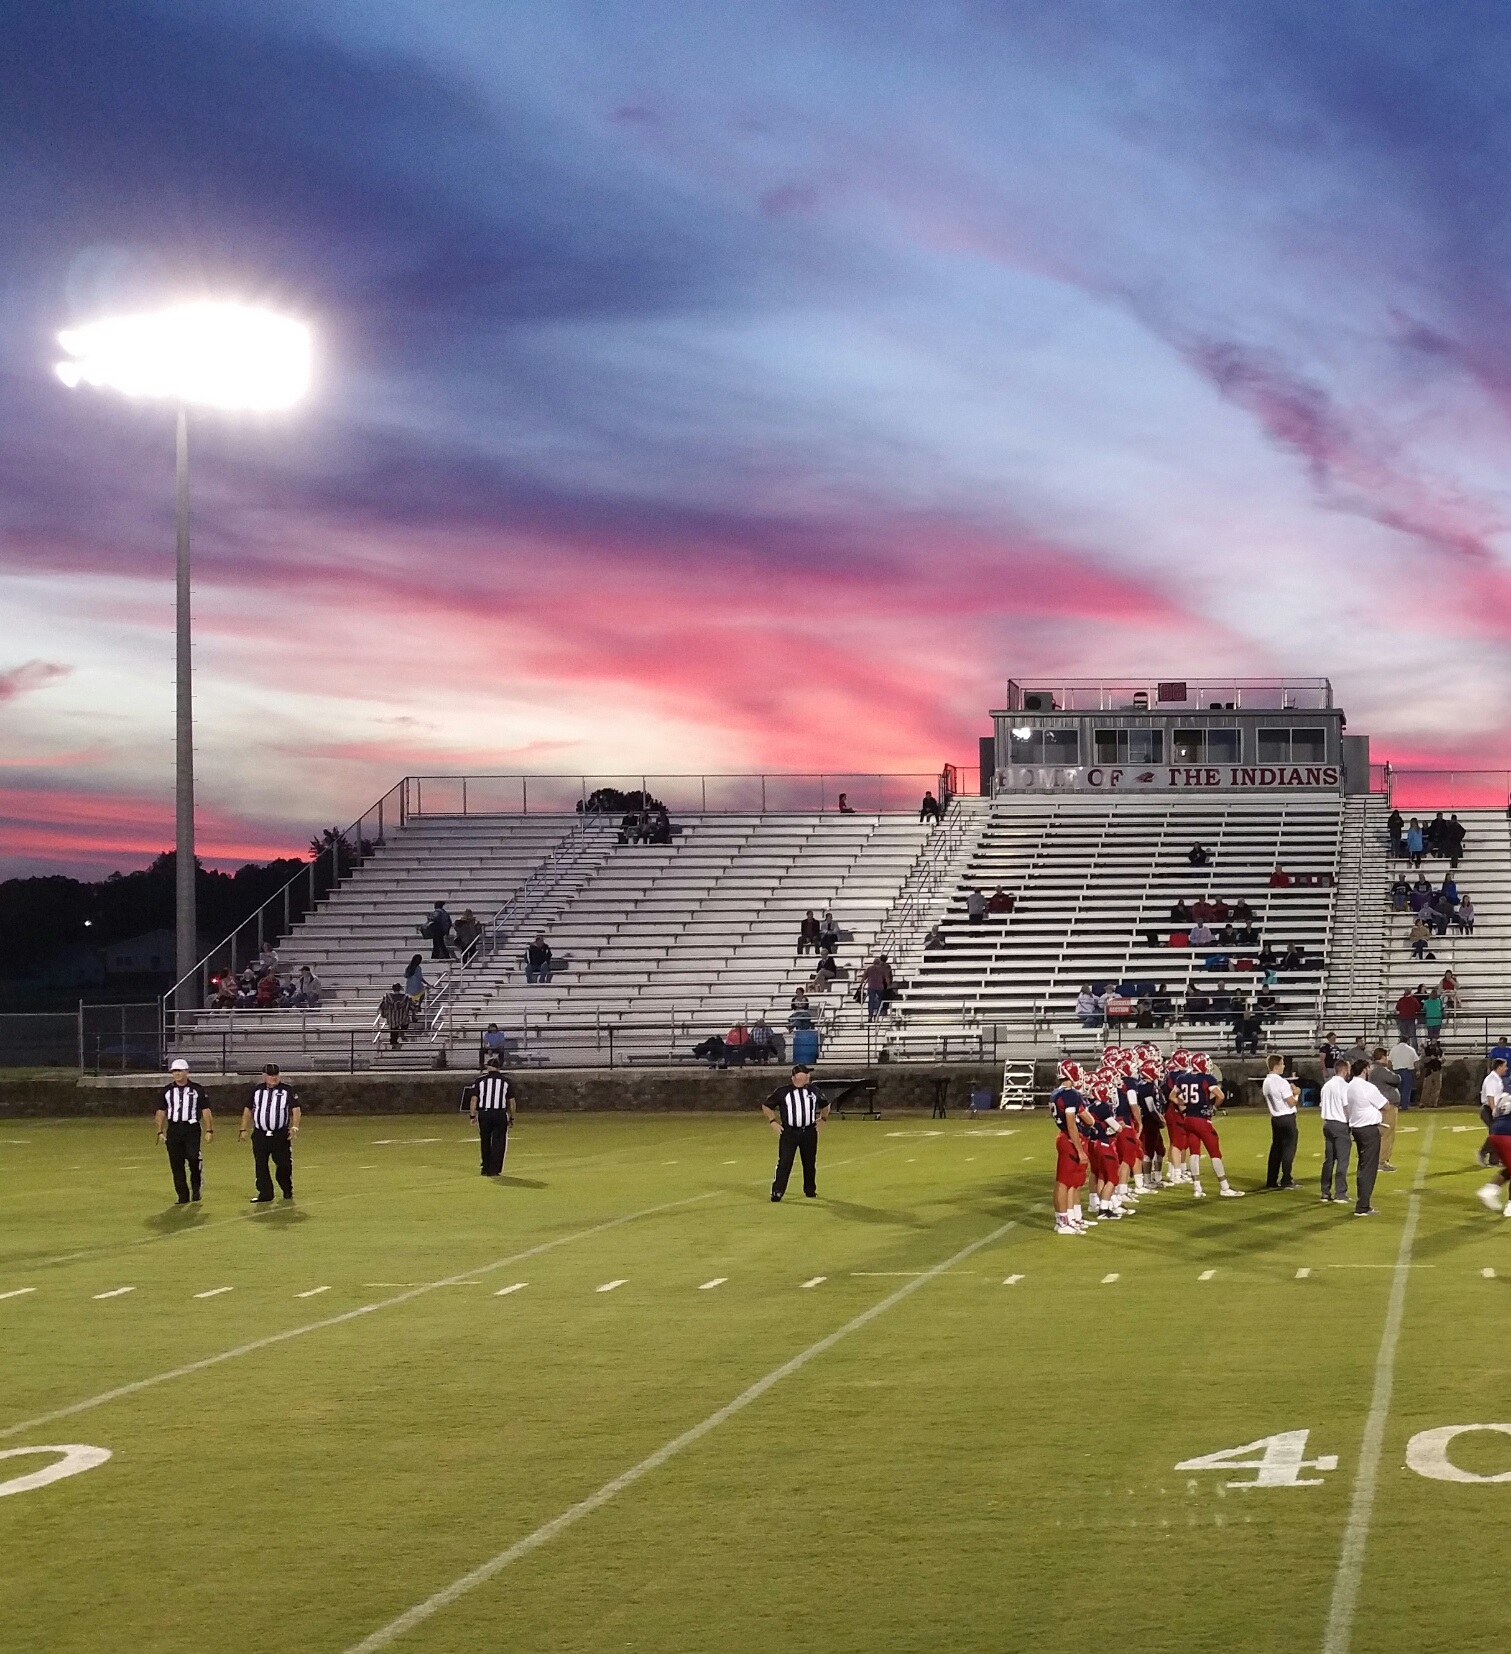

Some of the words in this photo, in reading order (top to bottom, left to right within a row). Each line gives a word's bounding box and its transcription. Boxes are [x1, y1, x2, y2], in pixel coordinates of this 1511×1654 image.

[1087, 768, 1124, 787] OF
[1168, 768, 1222, 786] THE
[1230, 767, 1339, 786] INDIANS
[1181, 1083, 1200, 1104] 35
